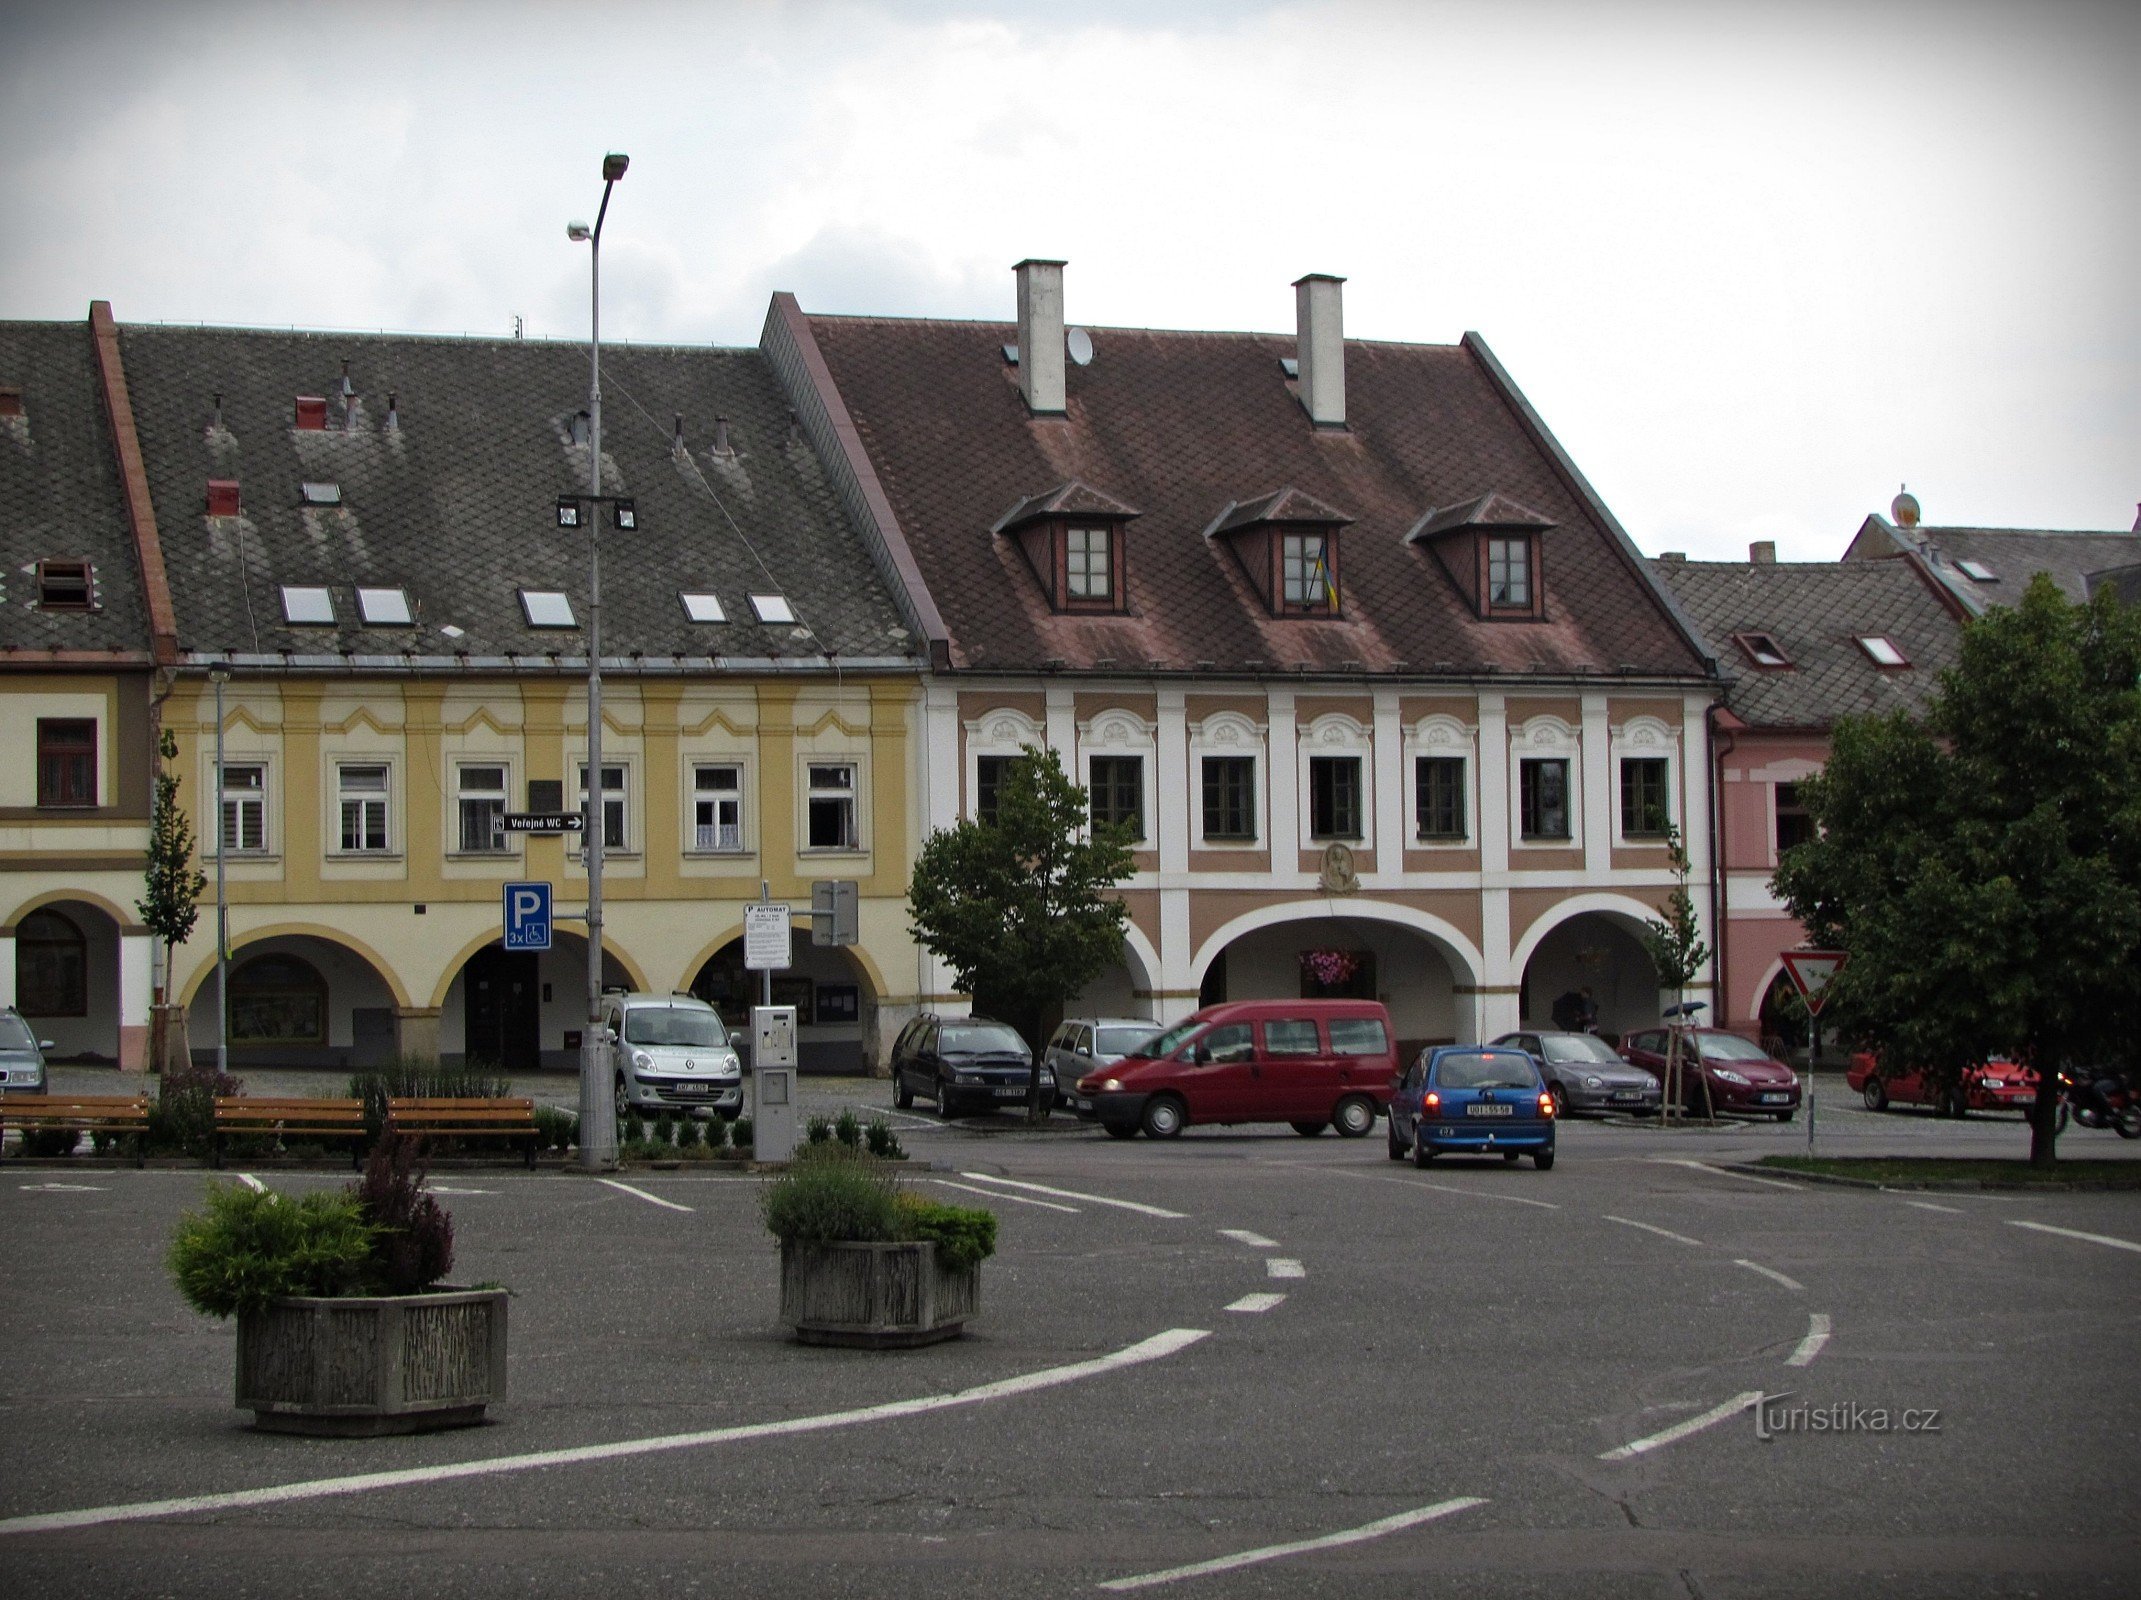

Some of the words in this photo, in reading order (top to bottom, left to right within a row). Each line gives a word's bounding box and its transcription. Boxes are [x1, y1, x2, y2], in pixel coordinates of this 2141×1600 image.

[511, 818, 544, 830] Veřejné
[546, 818, 561, 828] WC
[514, 891, 541, 929] P
[510, 932, 523, 943] 3x
